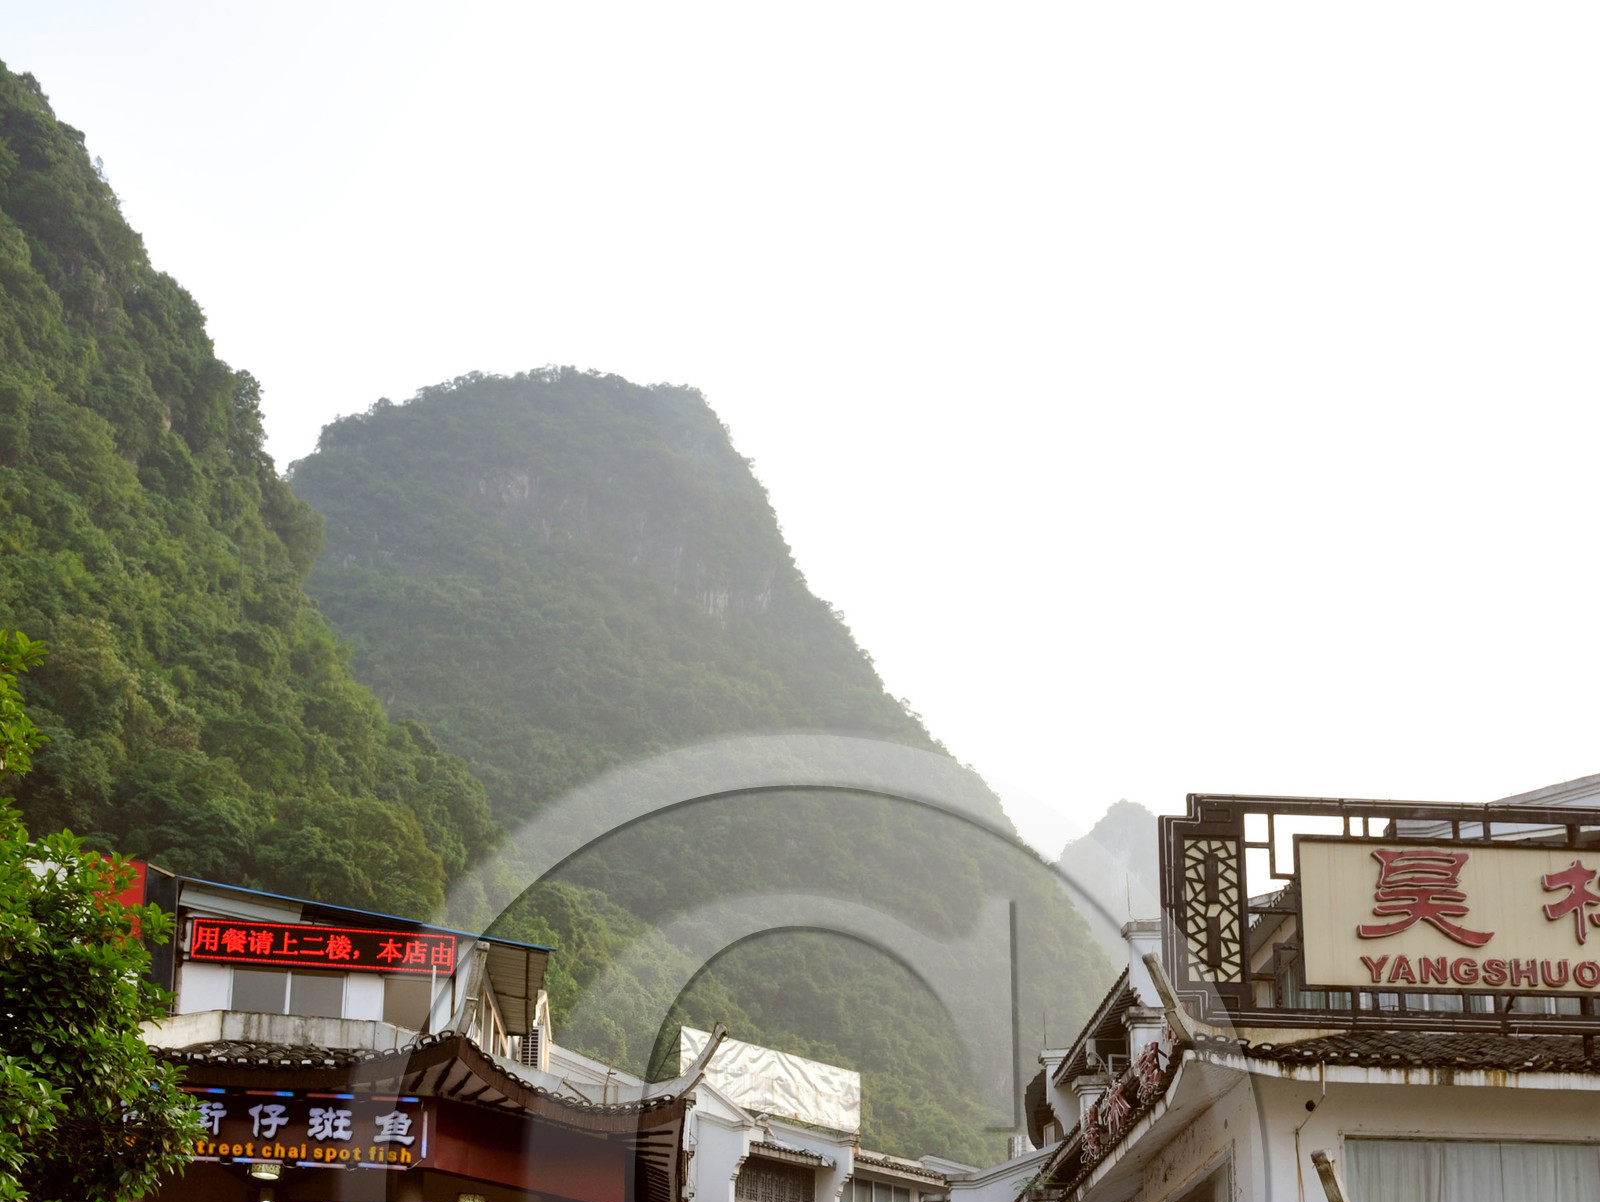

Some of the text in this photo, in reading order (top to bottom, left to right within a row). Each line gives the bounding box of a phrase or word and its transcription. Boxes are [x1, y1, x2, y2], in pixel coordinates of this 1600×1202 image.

[1360, 954, 1600, 988] YANGSHUO
[120, 1100, 415, 1145] 街仔斑鱼
[180, 1140, 254, 1157] treet
[262, 1143, 307, 1159] chai
[313, 1148, 362, 1162] spot
[368, 1146, 412, 1163] fish
